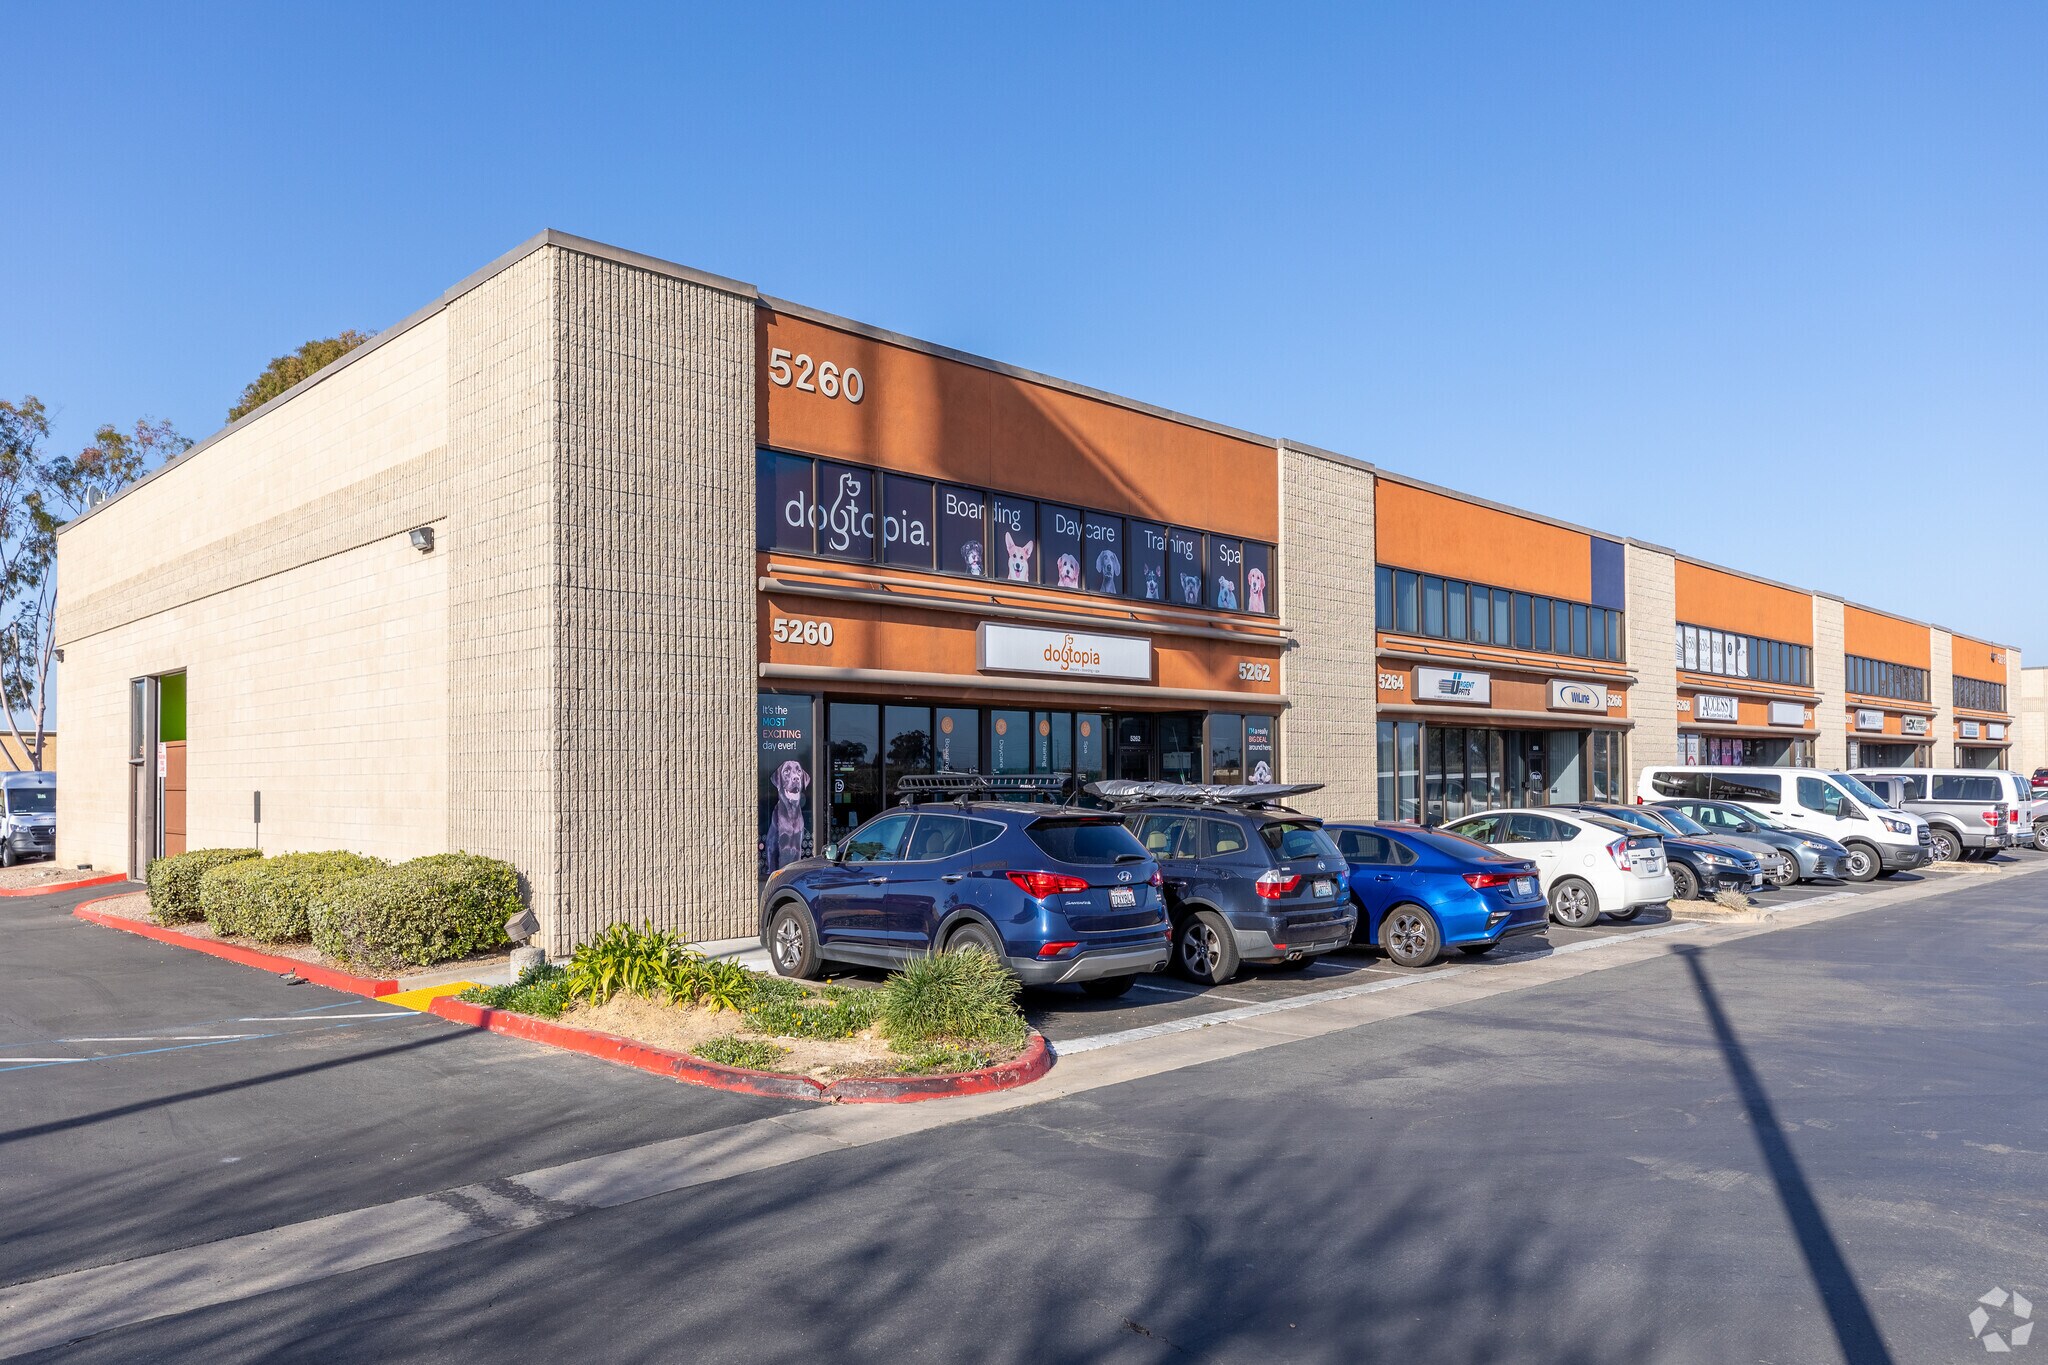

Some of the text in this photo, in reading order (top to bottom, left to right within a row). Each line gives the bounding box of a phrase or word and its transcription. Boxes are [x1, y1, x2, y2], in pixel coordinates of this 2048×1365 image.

[769, 348, 864, 403] 5260
[1056, 514, 1115, 542] Daycare
[1144, 530, 1193, 560] Training
[1219, 544, 1240, 566] Spa
[773, 618, 833, 646] 5260
[1044, 633, 1100, 670] dogtopia
[1239, 662, 1271, 682] 5262
[1379, 674, 1404, 690] 5264
[762, 706, 788, 715] It's the
[1702, 696, 1729, 716] ACCESS
[762, 718, 786, 726] MOST
[762, 729, 801, 738] EXCITING
[762, 741, 797, 751] day ever!
